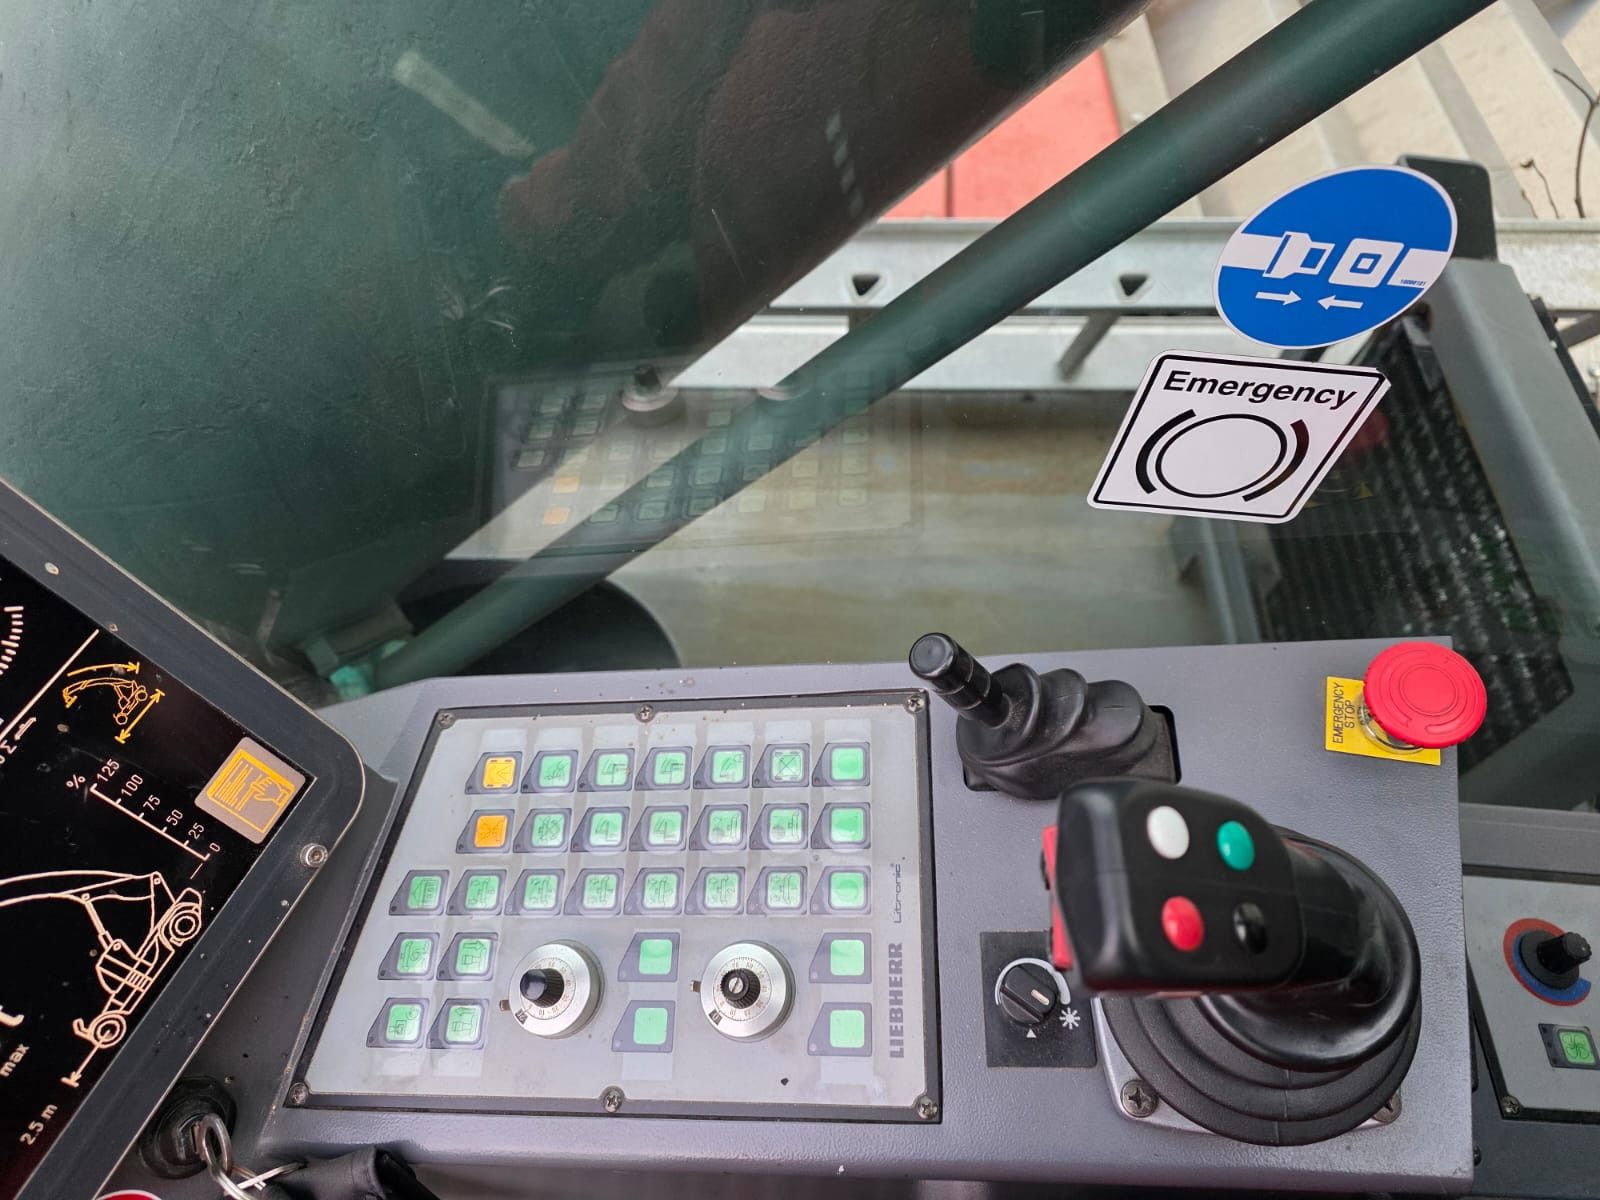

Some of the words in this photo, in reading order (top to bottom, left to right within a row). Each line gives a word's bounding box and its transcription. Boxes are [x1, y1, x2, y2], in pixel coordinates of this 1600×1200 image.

[1163, 370, 1358, 411] Emergency
[1332, 681, 1344, 744] EMERGENCY
[1344, 699, 1355, 728] STOP
[97, 758, 120, 782] 125
[121, 774, 144, 797] 100
[142, 794, 161, 811] 75
[165, 809, 184, 826] 50
[187, 822, 205, 840] 25
[209, 842, 221, 853] 0
[888, 942, 905, 1059] LIEBHERR
[0, 1043, 30, 1077] max
[19, 1120, 44, 1145] 2.5
[40, 1104, 58, 1120] m
